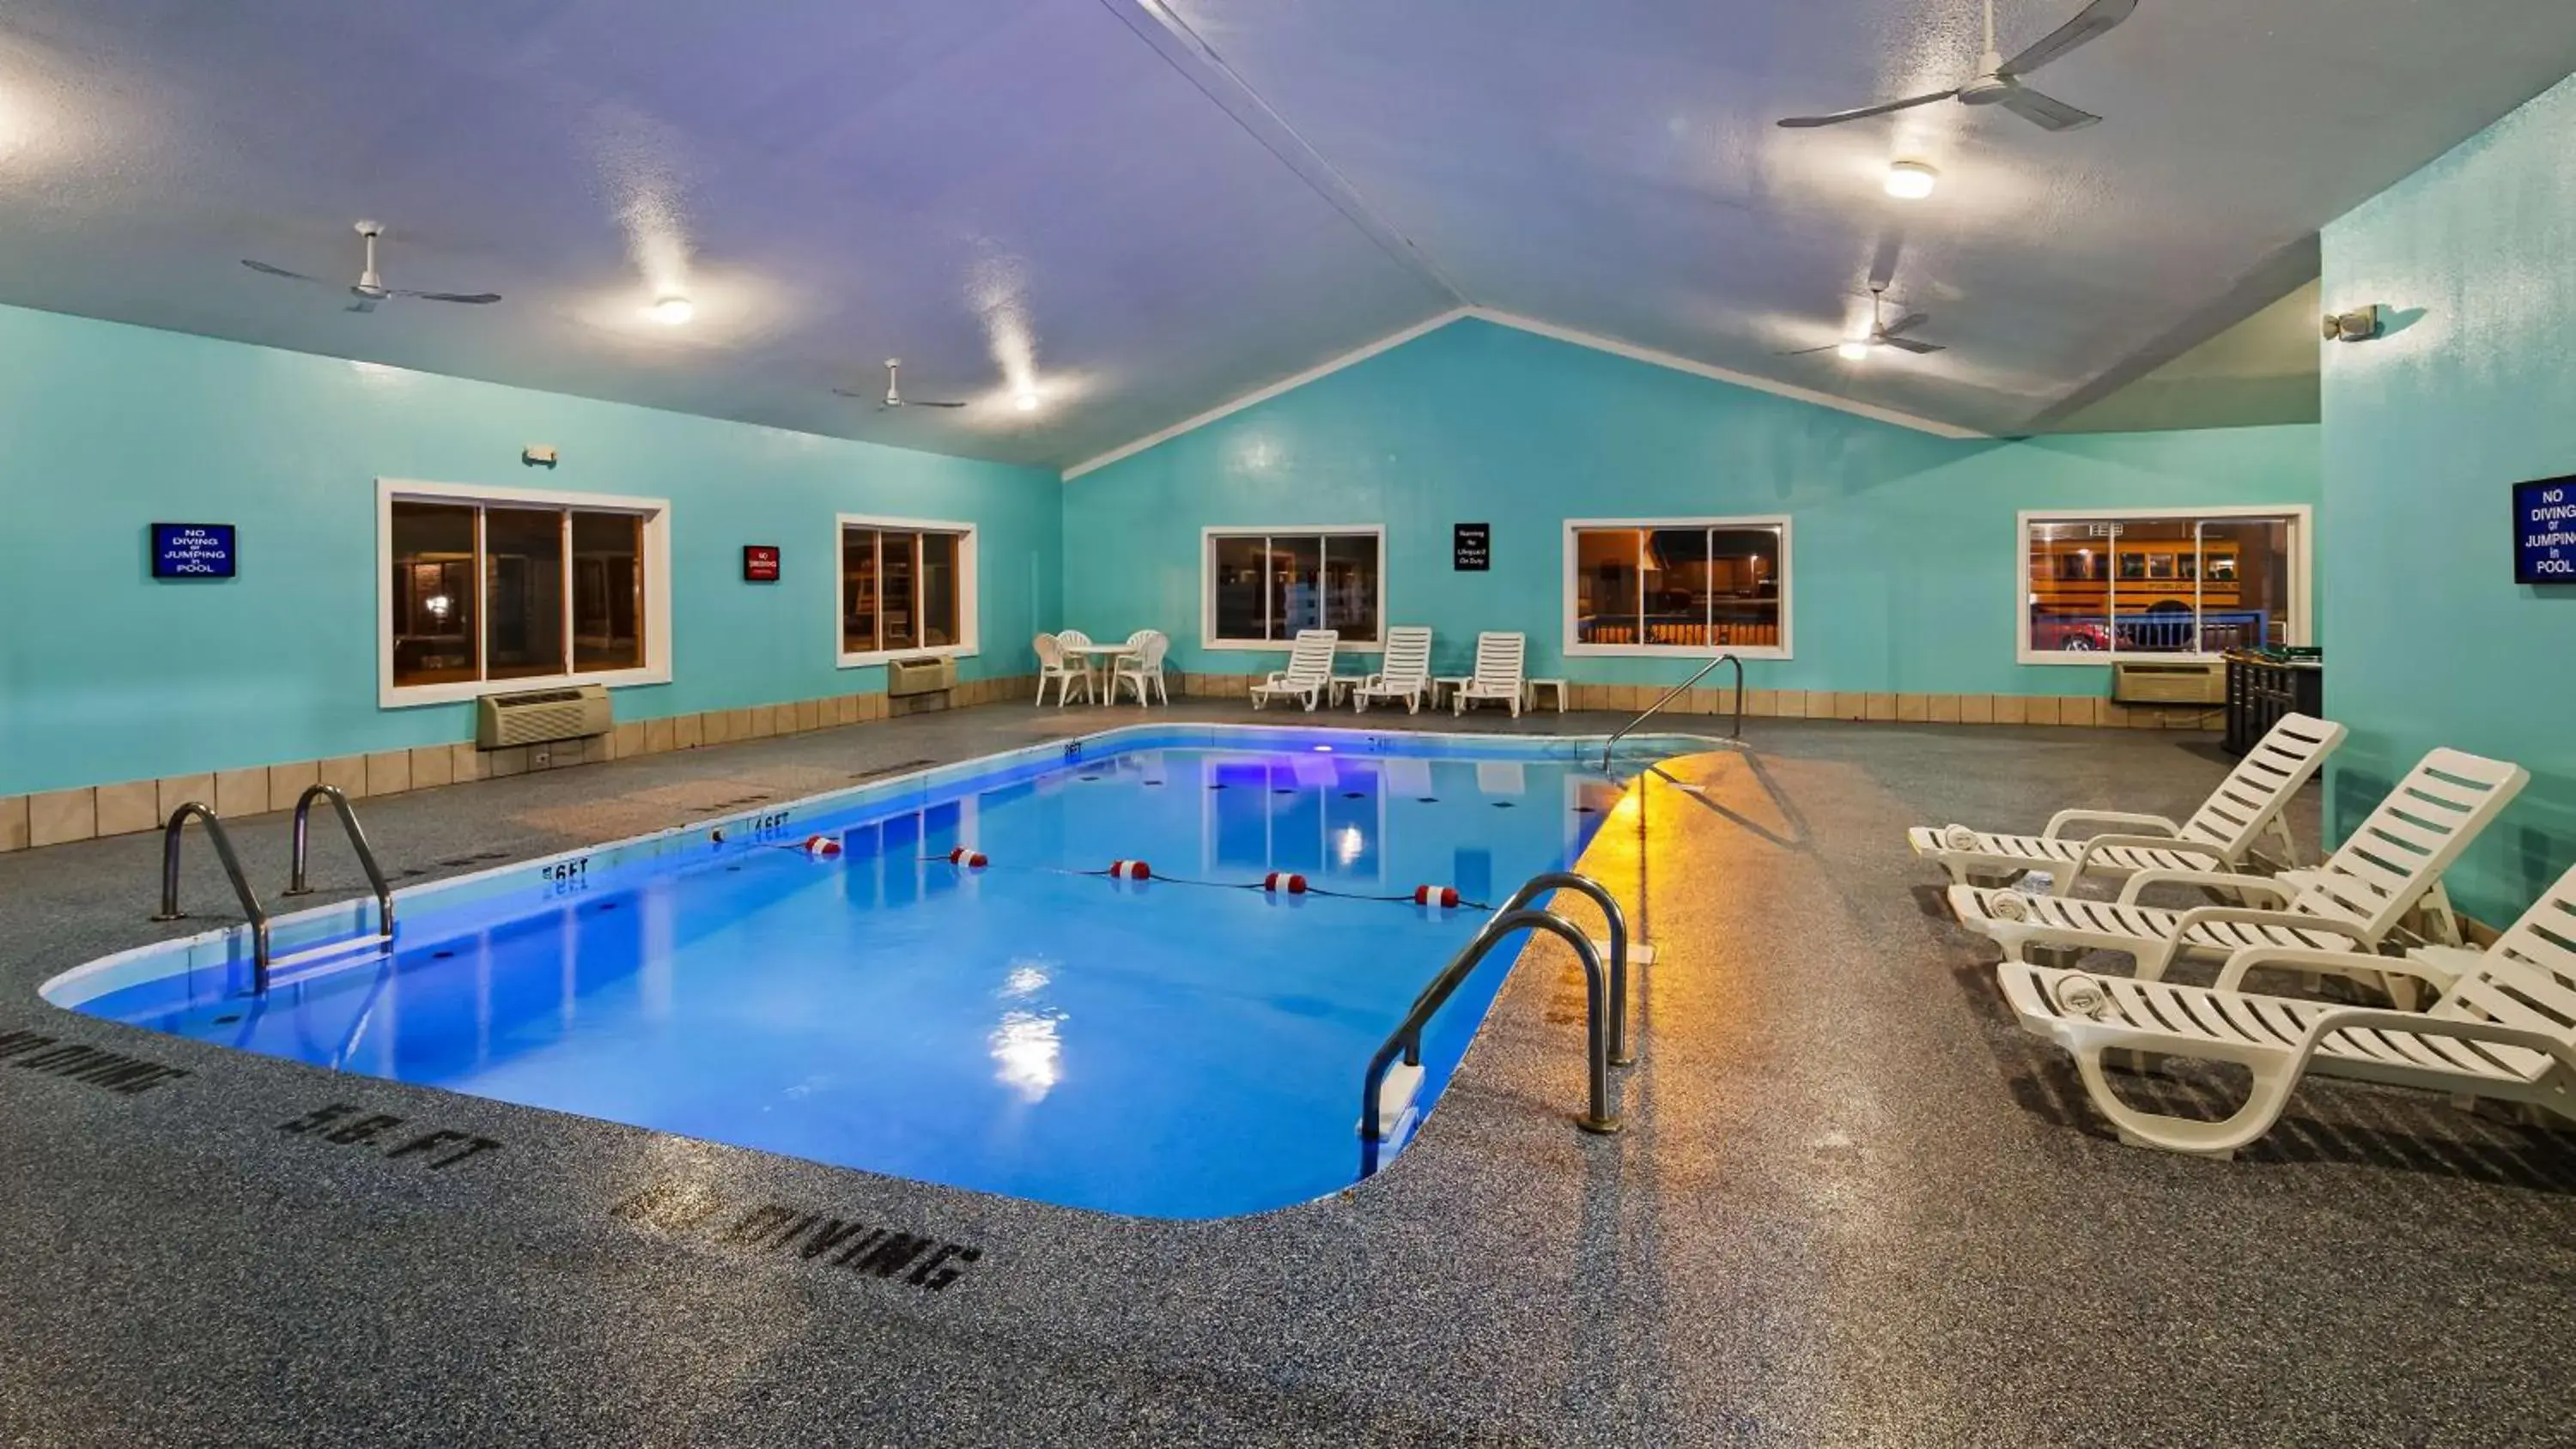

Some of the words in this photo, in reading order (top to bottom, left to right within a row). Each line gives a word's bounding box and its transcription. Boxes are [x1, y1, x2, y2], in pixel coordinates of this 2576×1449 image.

[2543, 488, 2563, 504] NO
[2531, 505, 2576, 521] DIVING
[2525, 532, 2576, 548] JUMPIN
[165, 550, 226, 559] JUMPING
[176, 564, 215, 573] POOL
[2537, 559, 2575, 573] POOL
